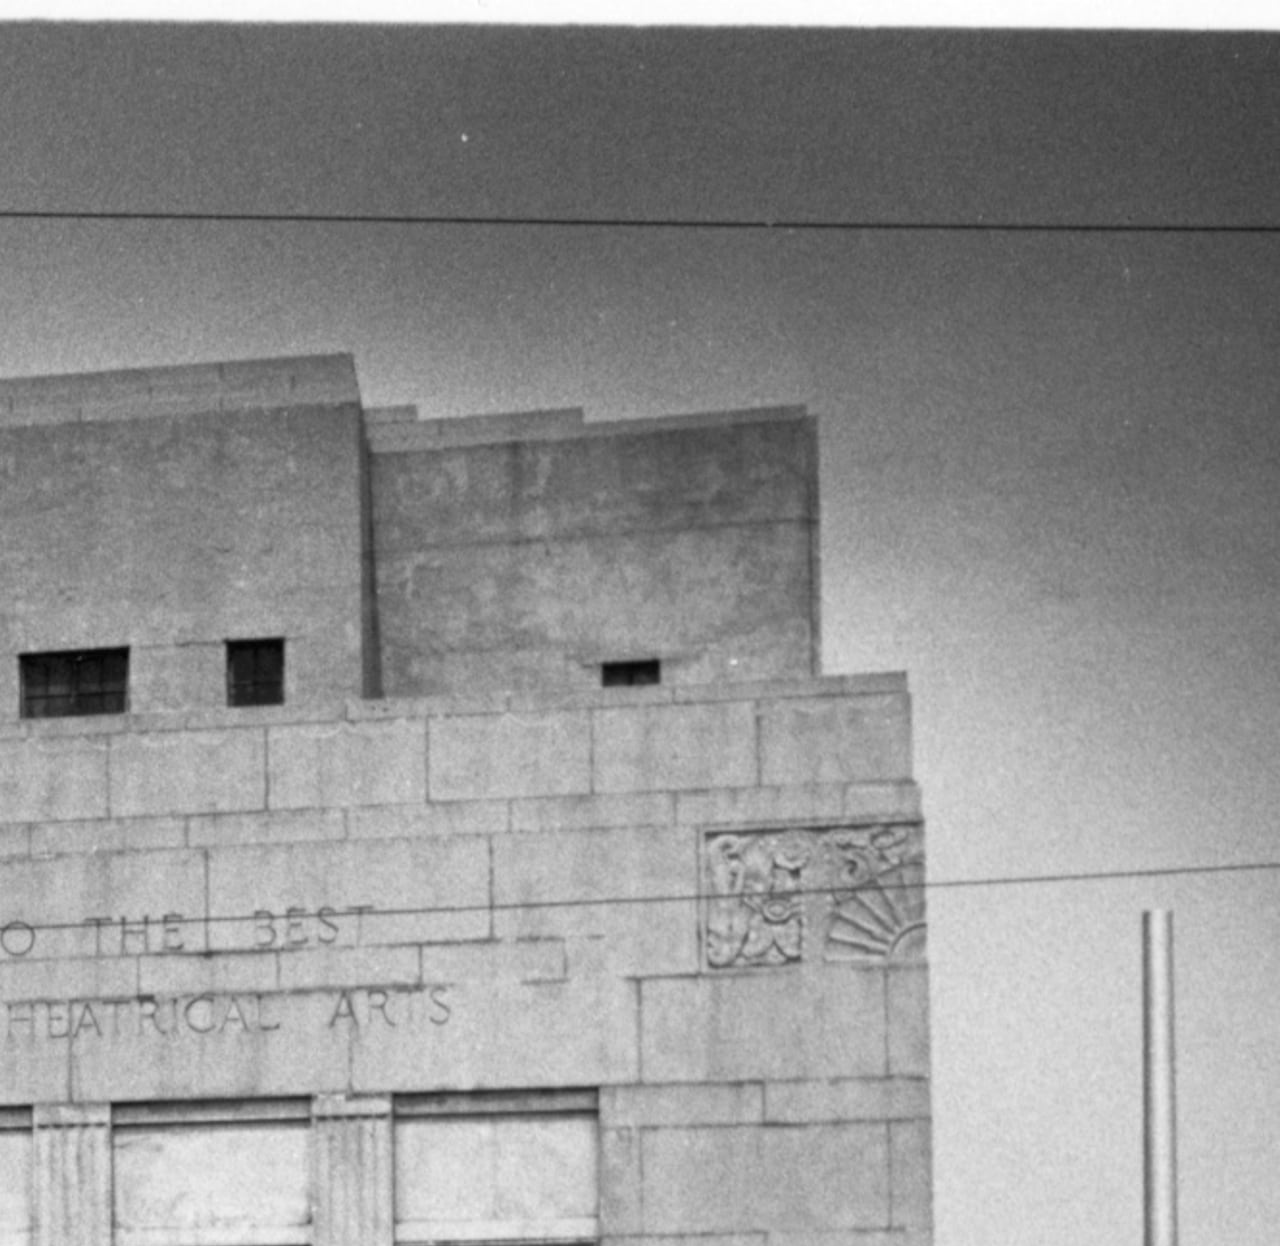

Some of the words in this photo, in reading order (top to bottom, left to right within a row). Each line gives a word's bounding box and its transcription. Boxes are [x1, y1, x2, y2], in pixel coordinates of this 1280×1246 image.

[81, 912, 186, 955] THE
[252, 905, 375, 949] BEST
[0, 993, 282, 1043] HEATRICAL
[328, 987, 452, 1029] ARTS
